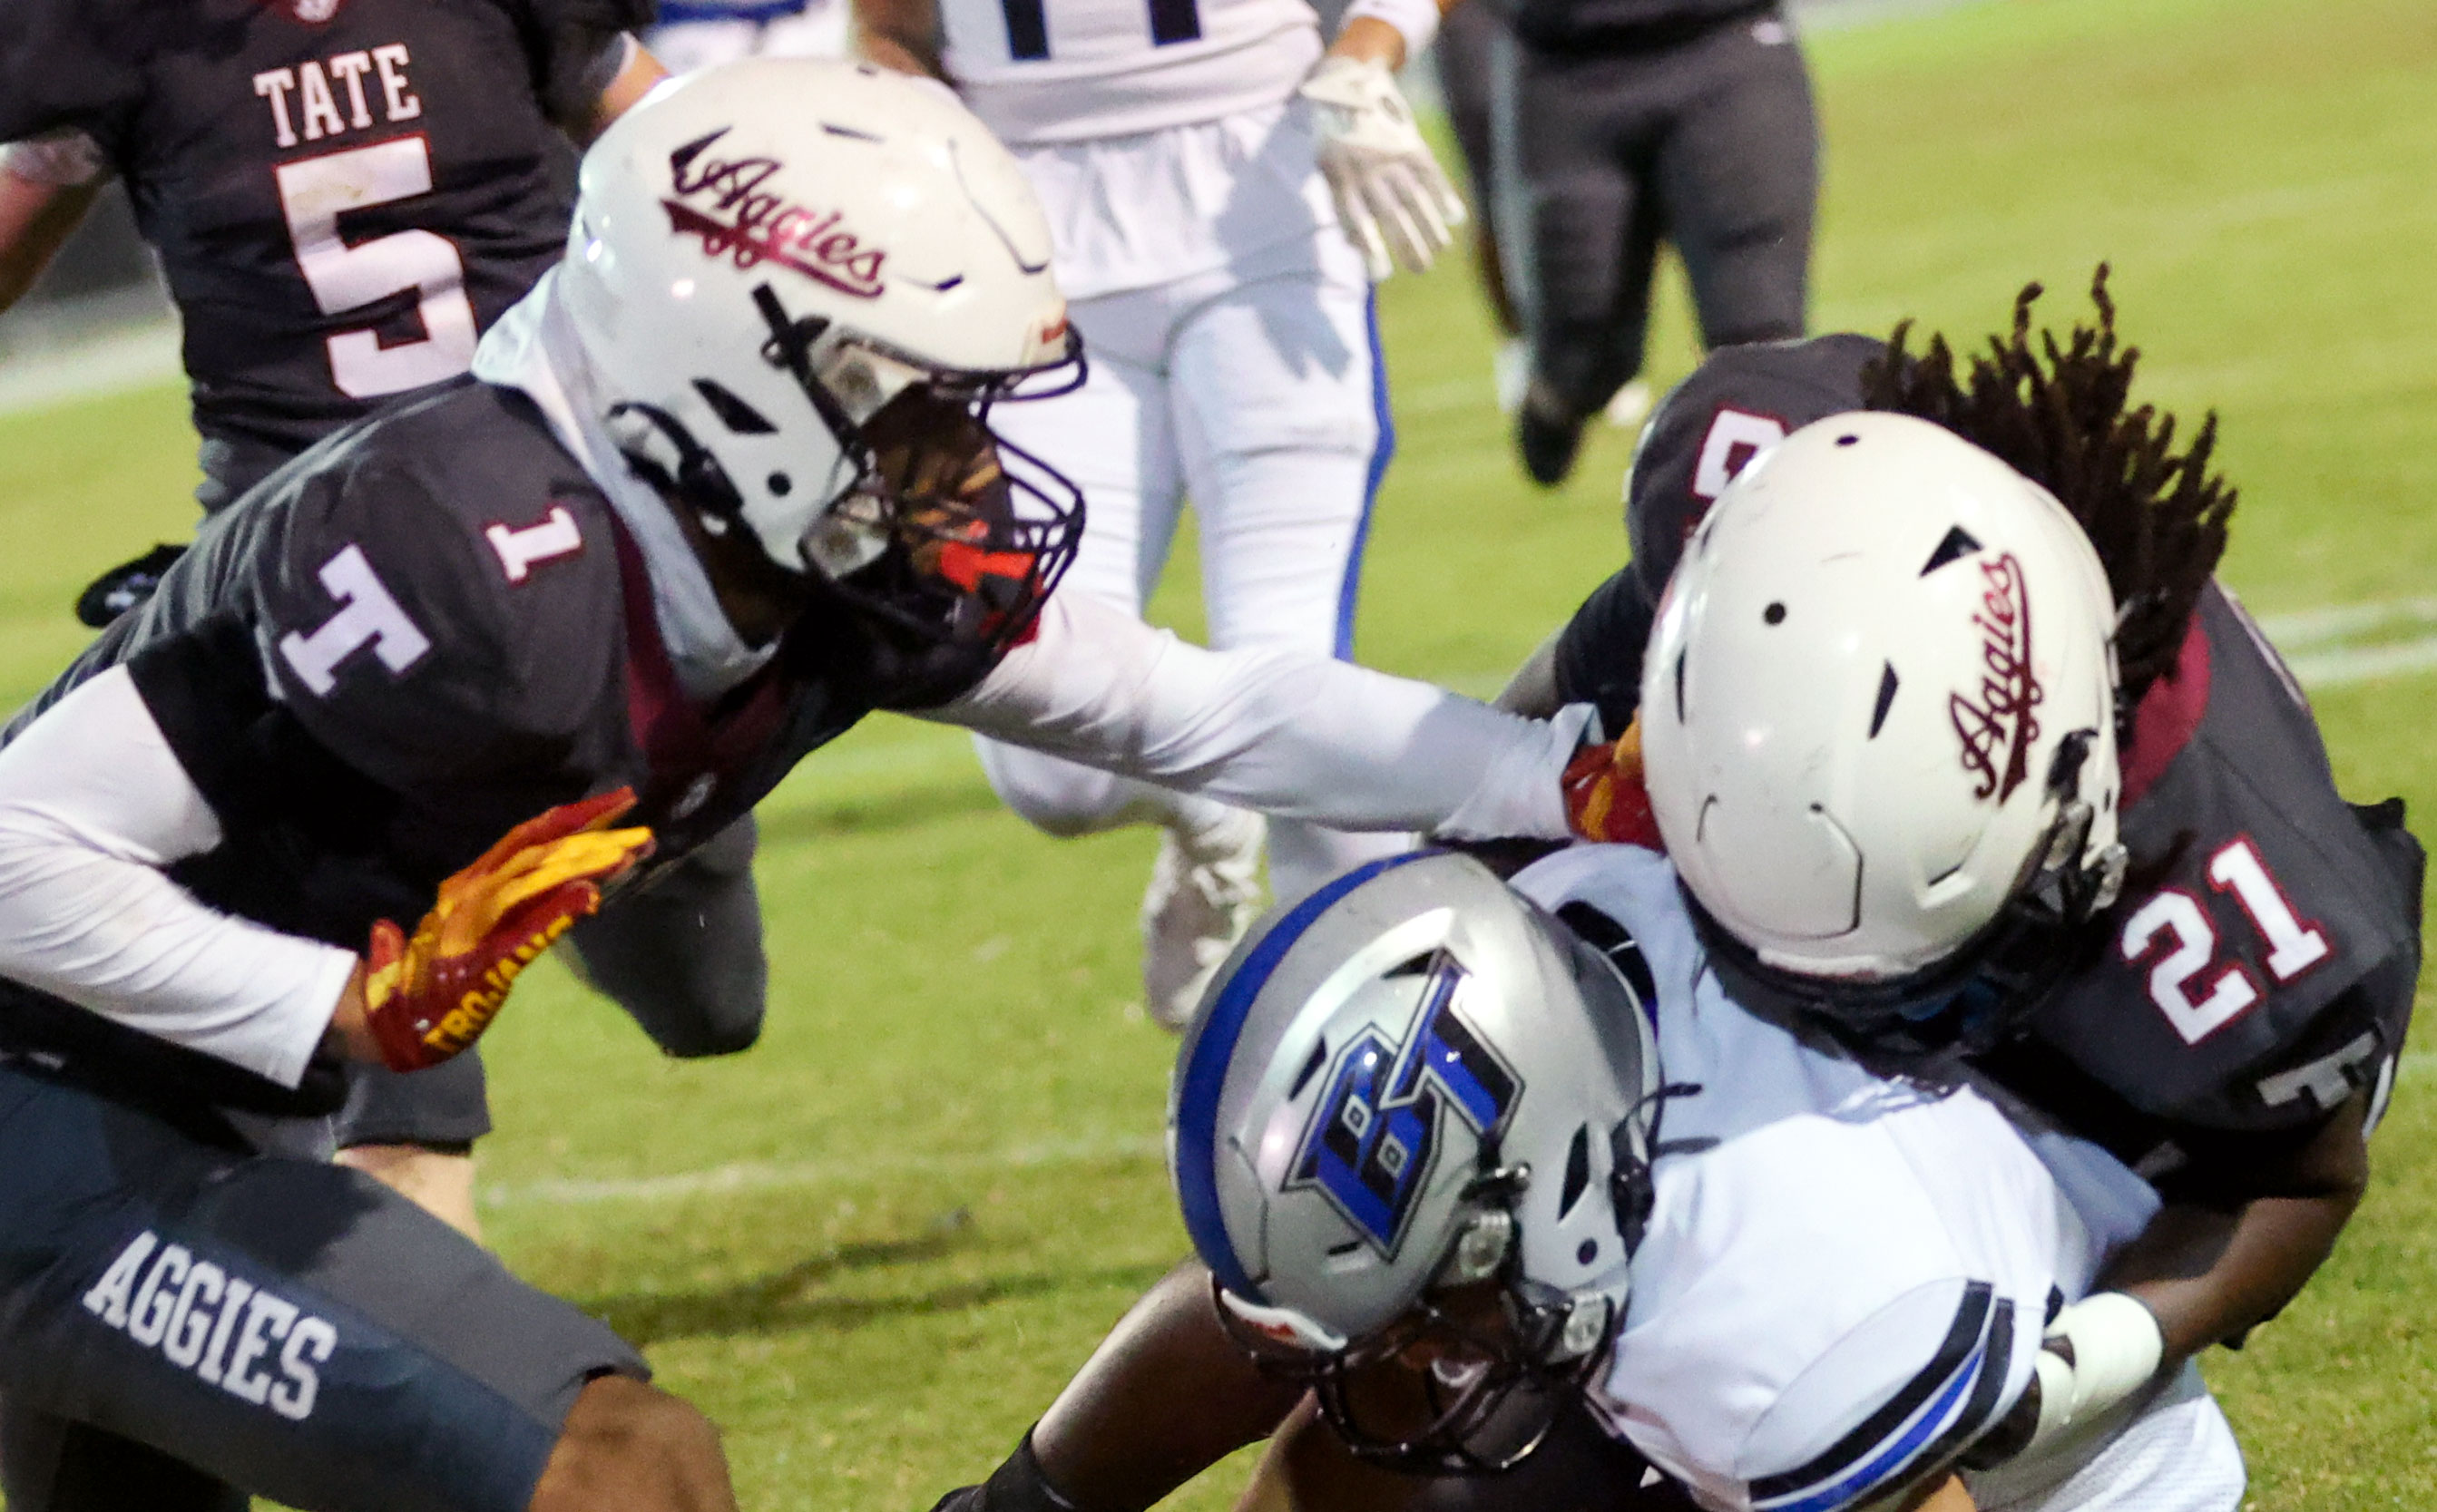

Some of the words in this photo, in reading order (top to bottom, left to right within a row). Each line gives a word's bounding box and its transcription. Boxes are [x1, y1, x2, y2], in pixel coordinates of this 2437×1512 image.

[254, 43, 421, 147] TATE
[275, 134, 478, 399] 5
[660, 157, 886, 298] Aggies
[279, 543, 431, 697] T
[485, 506, 582, 581] 1
[1948, 552, 2042, 807] Aggies
[2120, 839, 2329, 1047] 21
[82, 1229, 338, 1421] AGGIES
